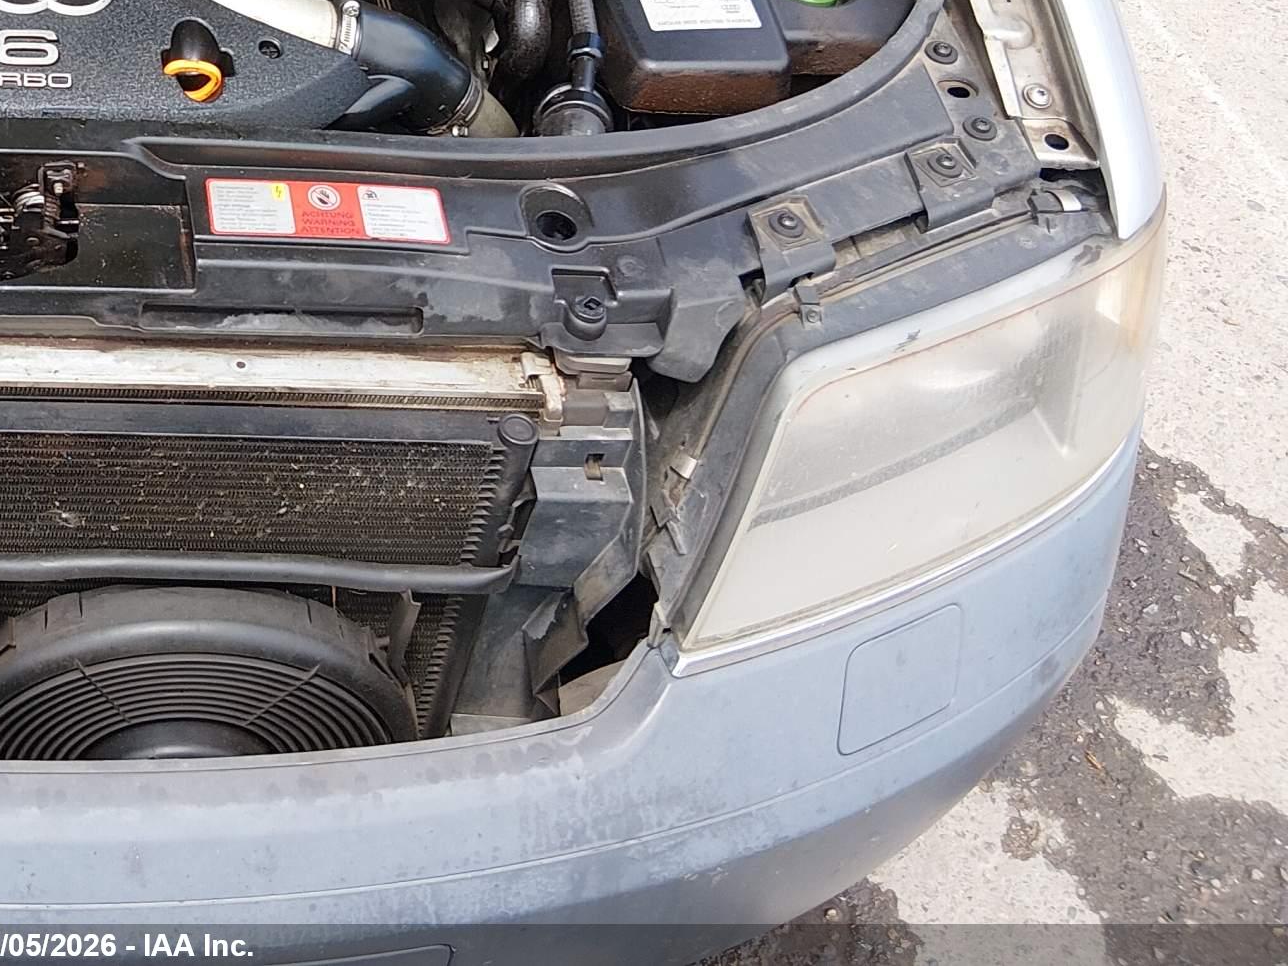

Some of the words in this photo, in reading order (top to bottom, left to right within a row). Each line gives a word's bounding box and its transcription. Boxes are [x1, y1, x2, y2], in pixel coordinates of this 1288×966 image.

[302, 210, 354, 219] ACHTUNG
[302, 218, 356, 227] WARNING
[300, 226, 361, 234] ATTENTION
